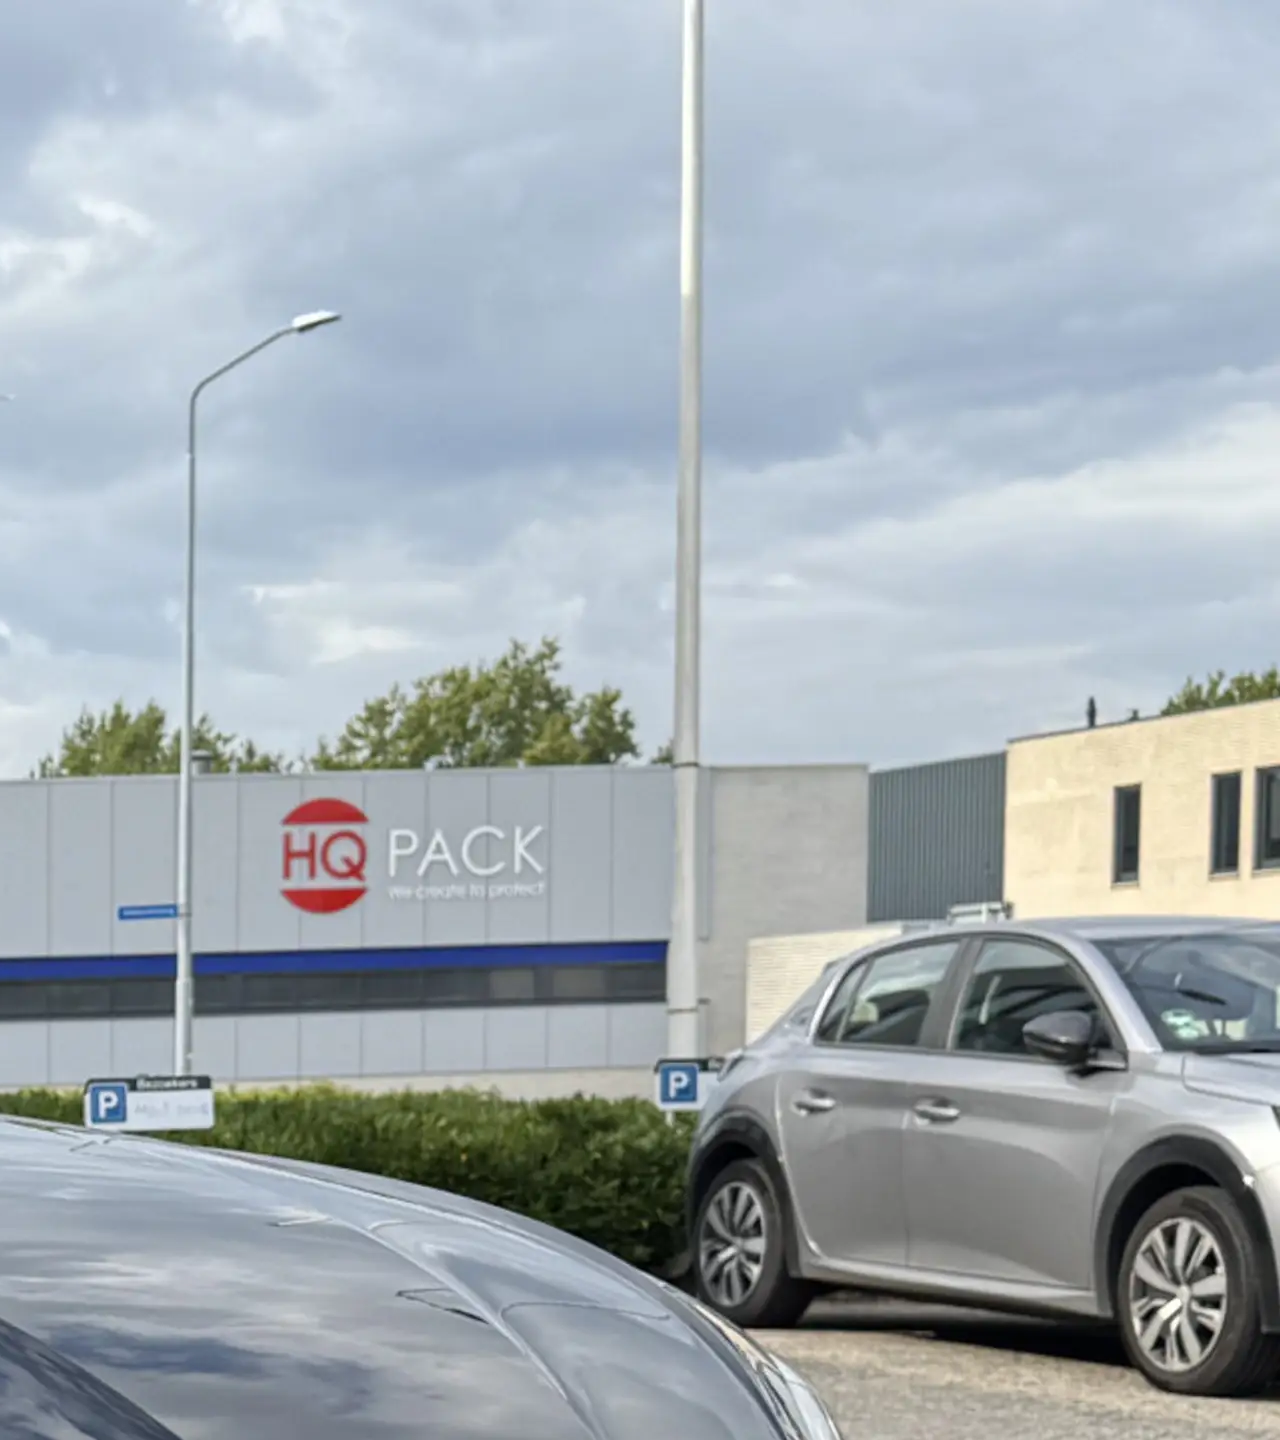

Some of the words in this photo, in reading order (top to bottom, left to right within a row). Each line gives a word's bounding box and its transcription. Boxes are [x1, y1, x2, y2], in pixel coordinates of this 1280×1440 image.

[281, 830, 367, 881] HQ
[389, 825, 545, 878] PACK
[668, 1070, 689, 1099] P
[98, 1090, 119, 1119] P
